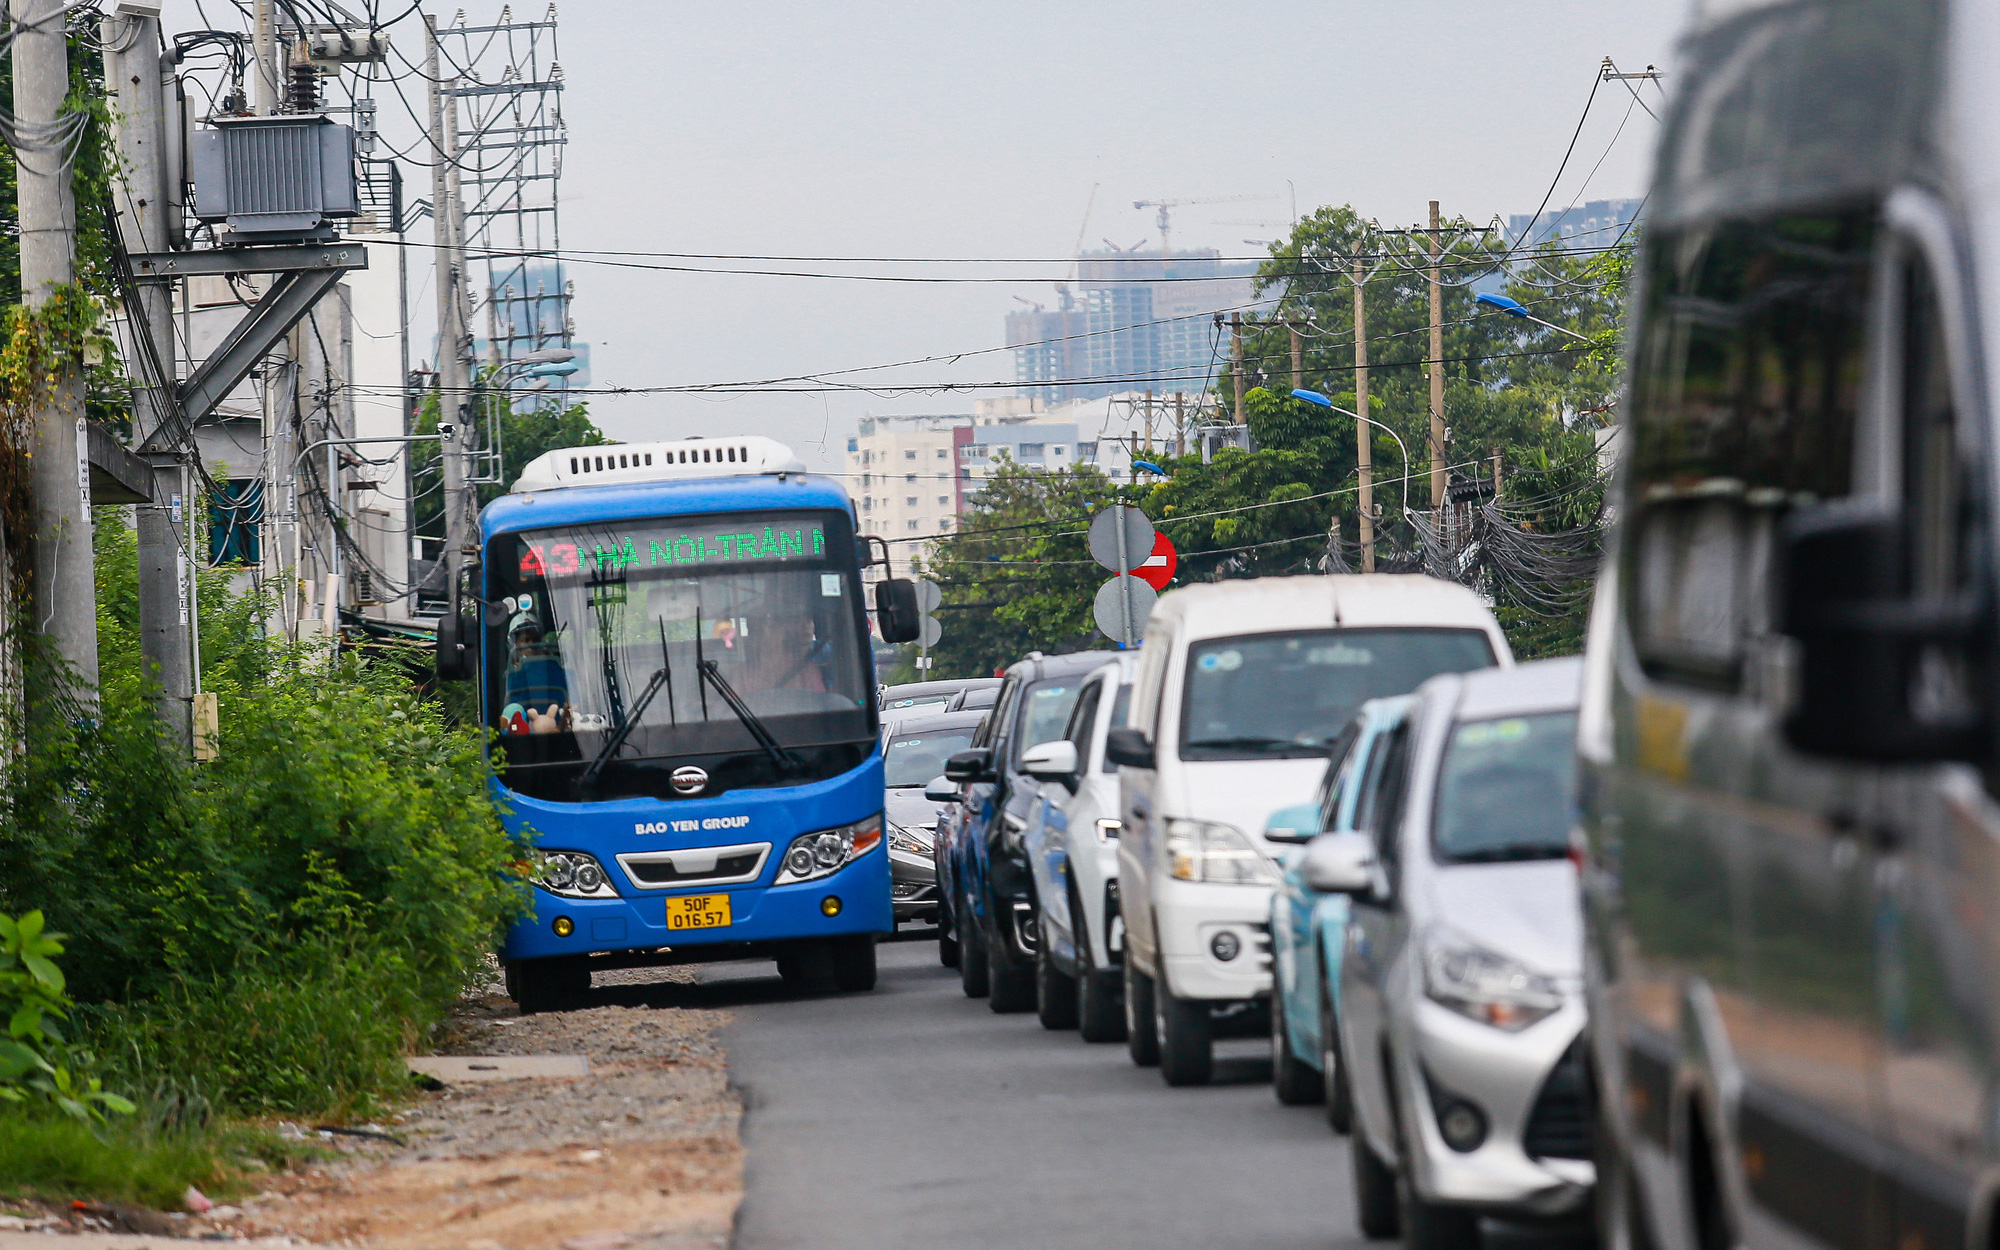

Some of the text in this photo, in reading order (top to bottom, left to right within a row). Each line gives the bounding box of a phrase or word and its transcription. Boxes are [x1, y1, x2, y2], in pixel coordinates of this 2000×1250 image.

[519, 542, 579, 576] 43
[596, 536, 642, 570] HÀ
[634, 815, 750, 836] BAO YEN GROUP
[683, 897, 711, 912] 50F
[673, 911, 723, 928] 016.57
